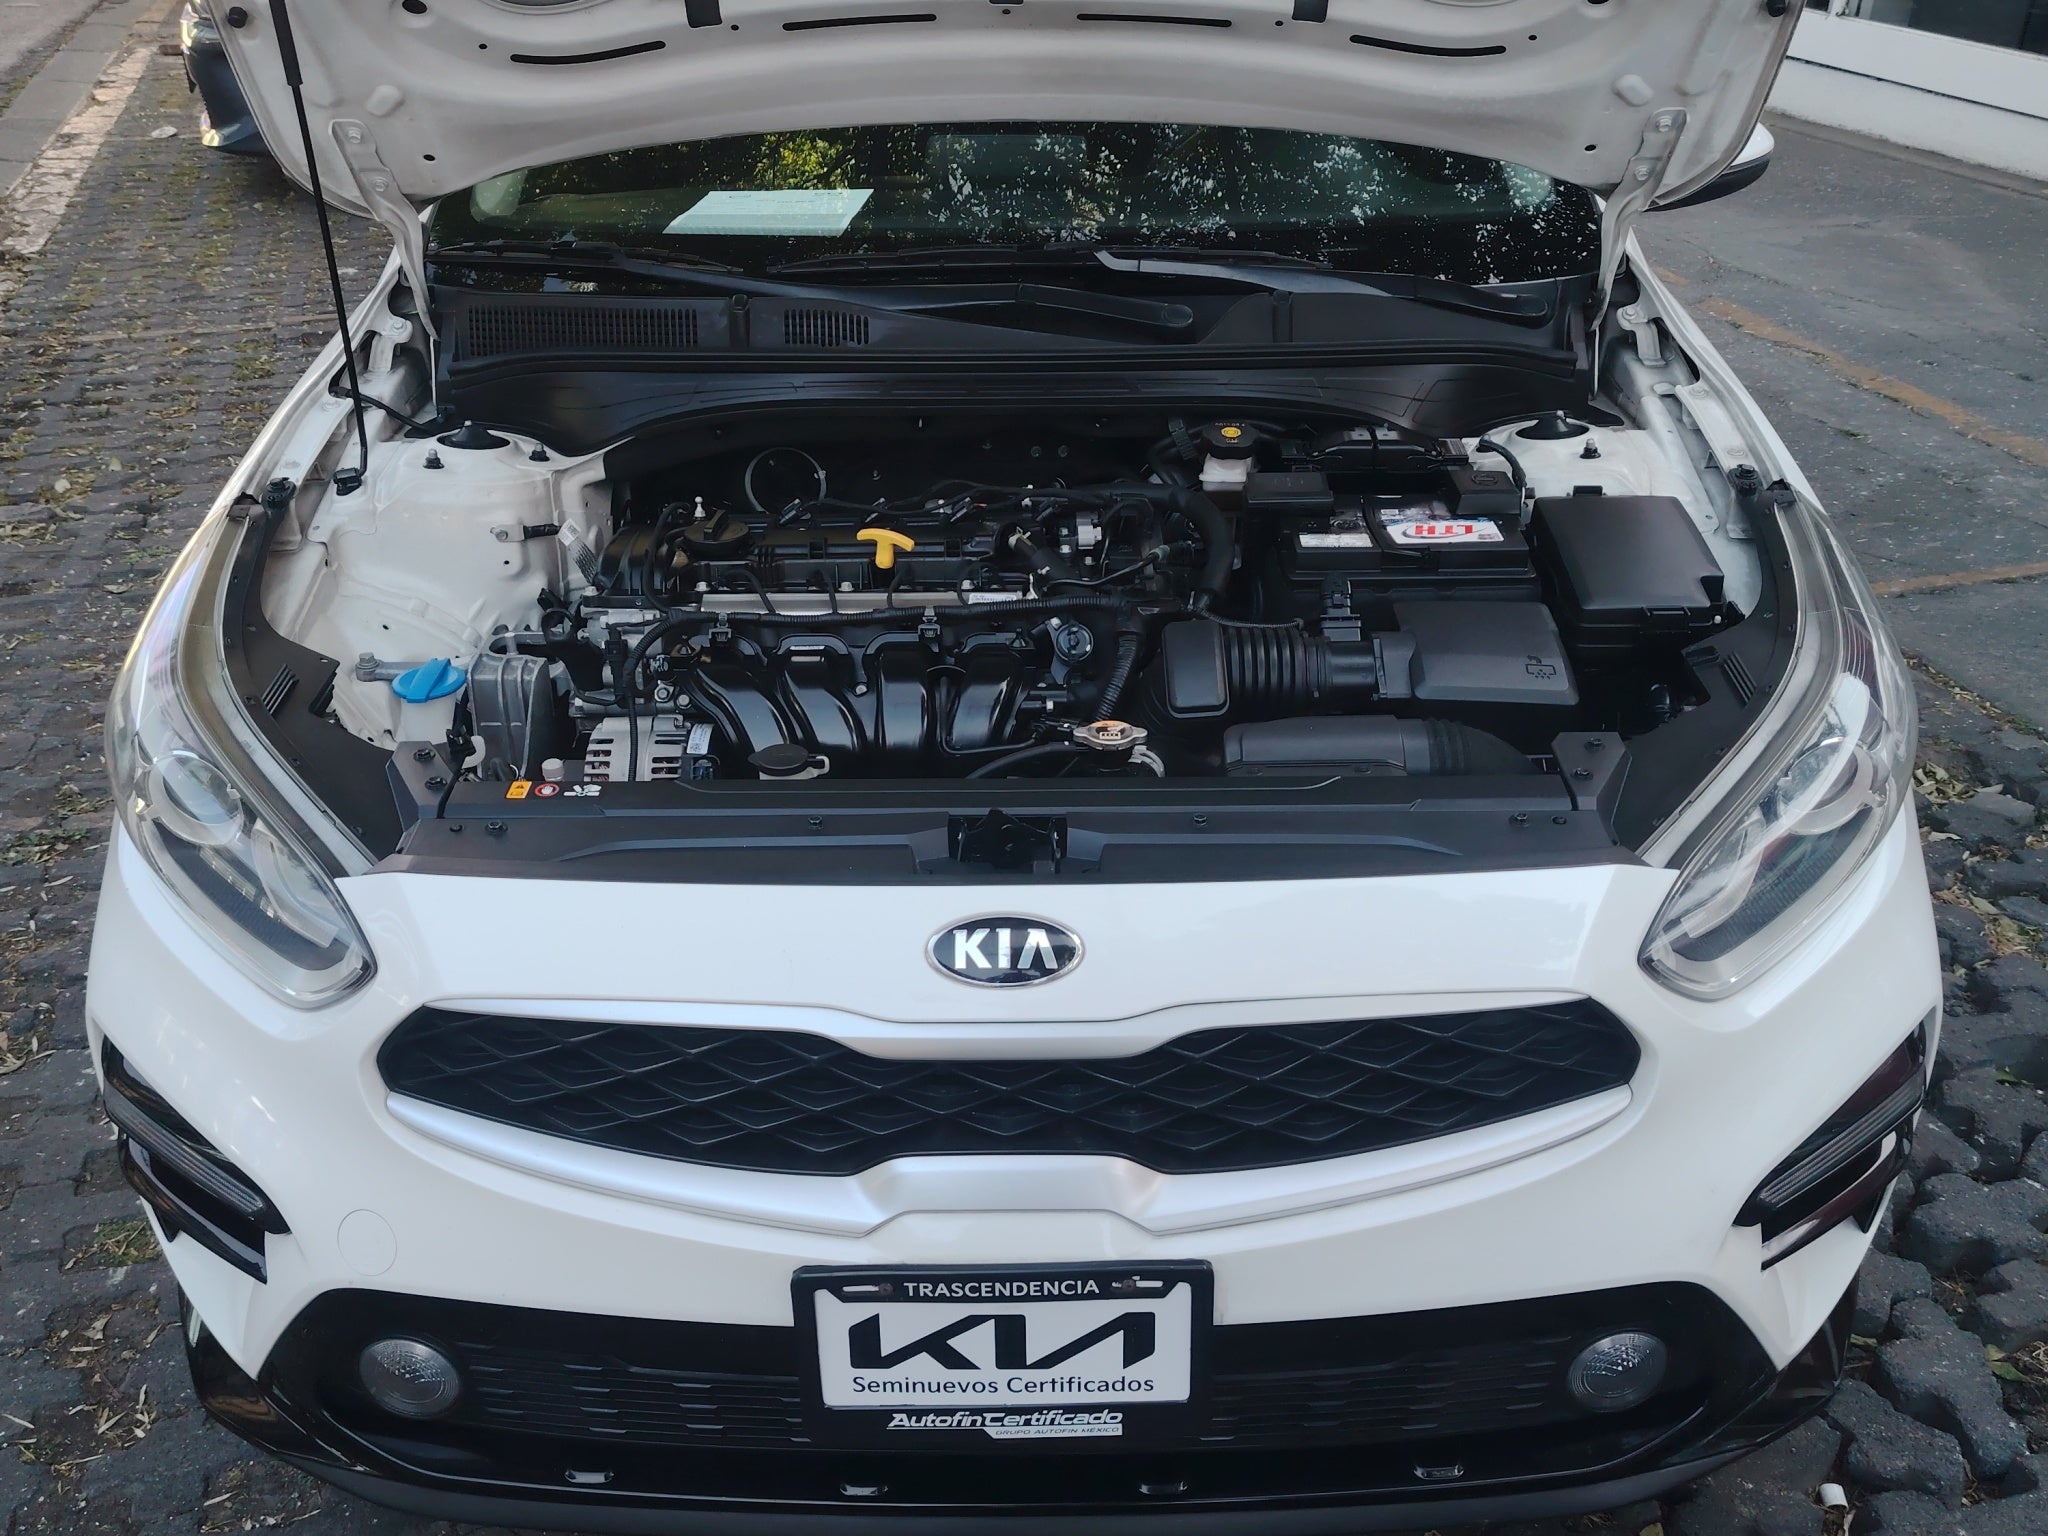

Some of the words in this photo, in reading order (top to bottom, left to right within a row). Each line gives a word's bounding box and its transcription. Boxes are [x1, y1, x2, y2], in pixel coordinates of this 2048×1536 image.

[1414, 524, 1474, 536] LTH
[952, 927, 1059, 970] KIA
[904, 1279, 1100, 1298] TRASCENDENCIA
[848, 1311, 1156, 1370] KIA
[852, 1376, 998, 1394] Seminuevos
[1006, 1375, 1155, 1393] Certificados
